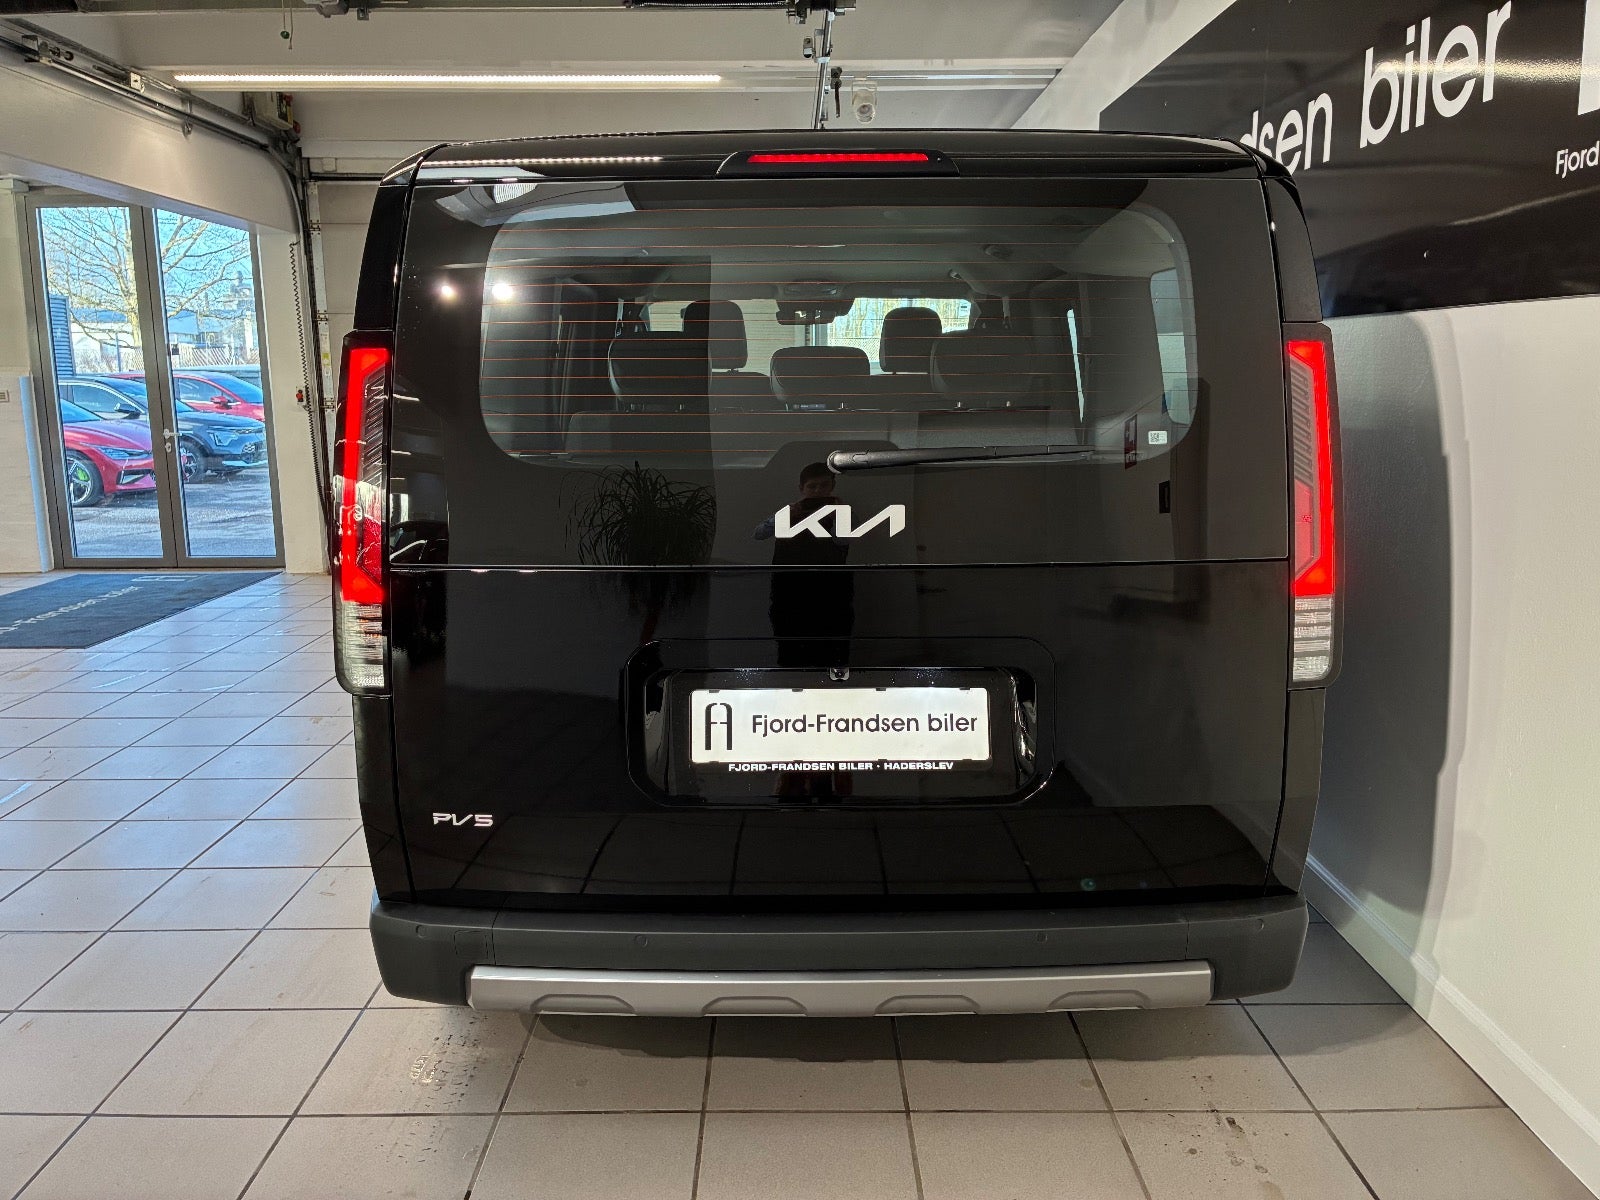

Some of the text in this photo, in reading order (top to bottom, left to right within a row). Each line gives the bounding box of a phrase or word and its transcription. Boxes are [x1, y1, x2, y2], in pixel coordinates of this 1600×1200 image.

[1360, 1, 1511, 149] biler
[1555, 140, 1600, 179] Fjord
[752, 713, 978, 737] Fjord-Frandsen biler
[728, 761, 954, 773] FJORD-FRANDSEN BILER HADERSLEV
